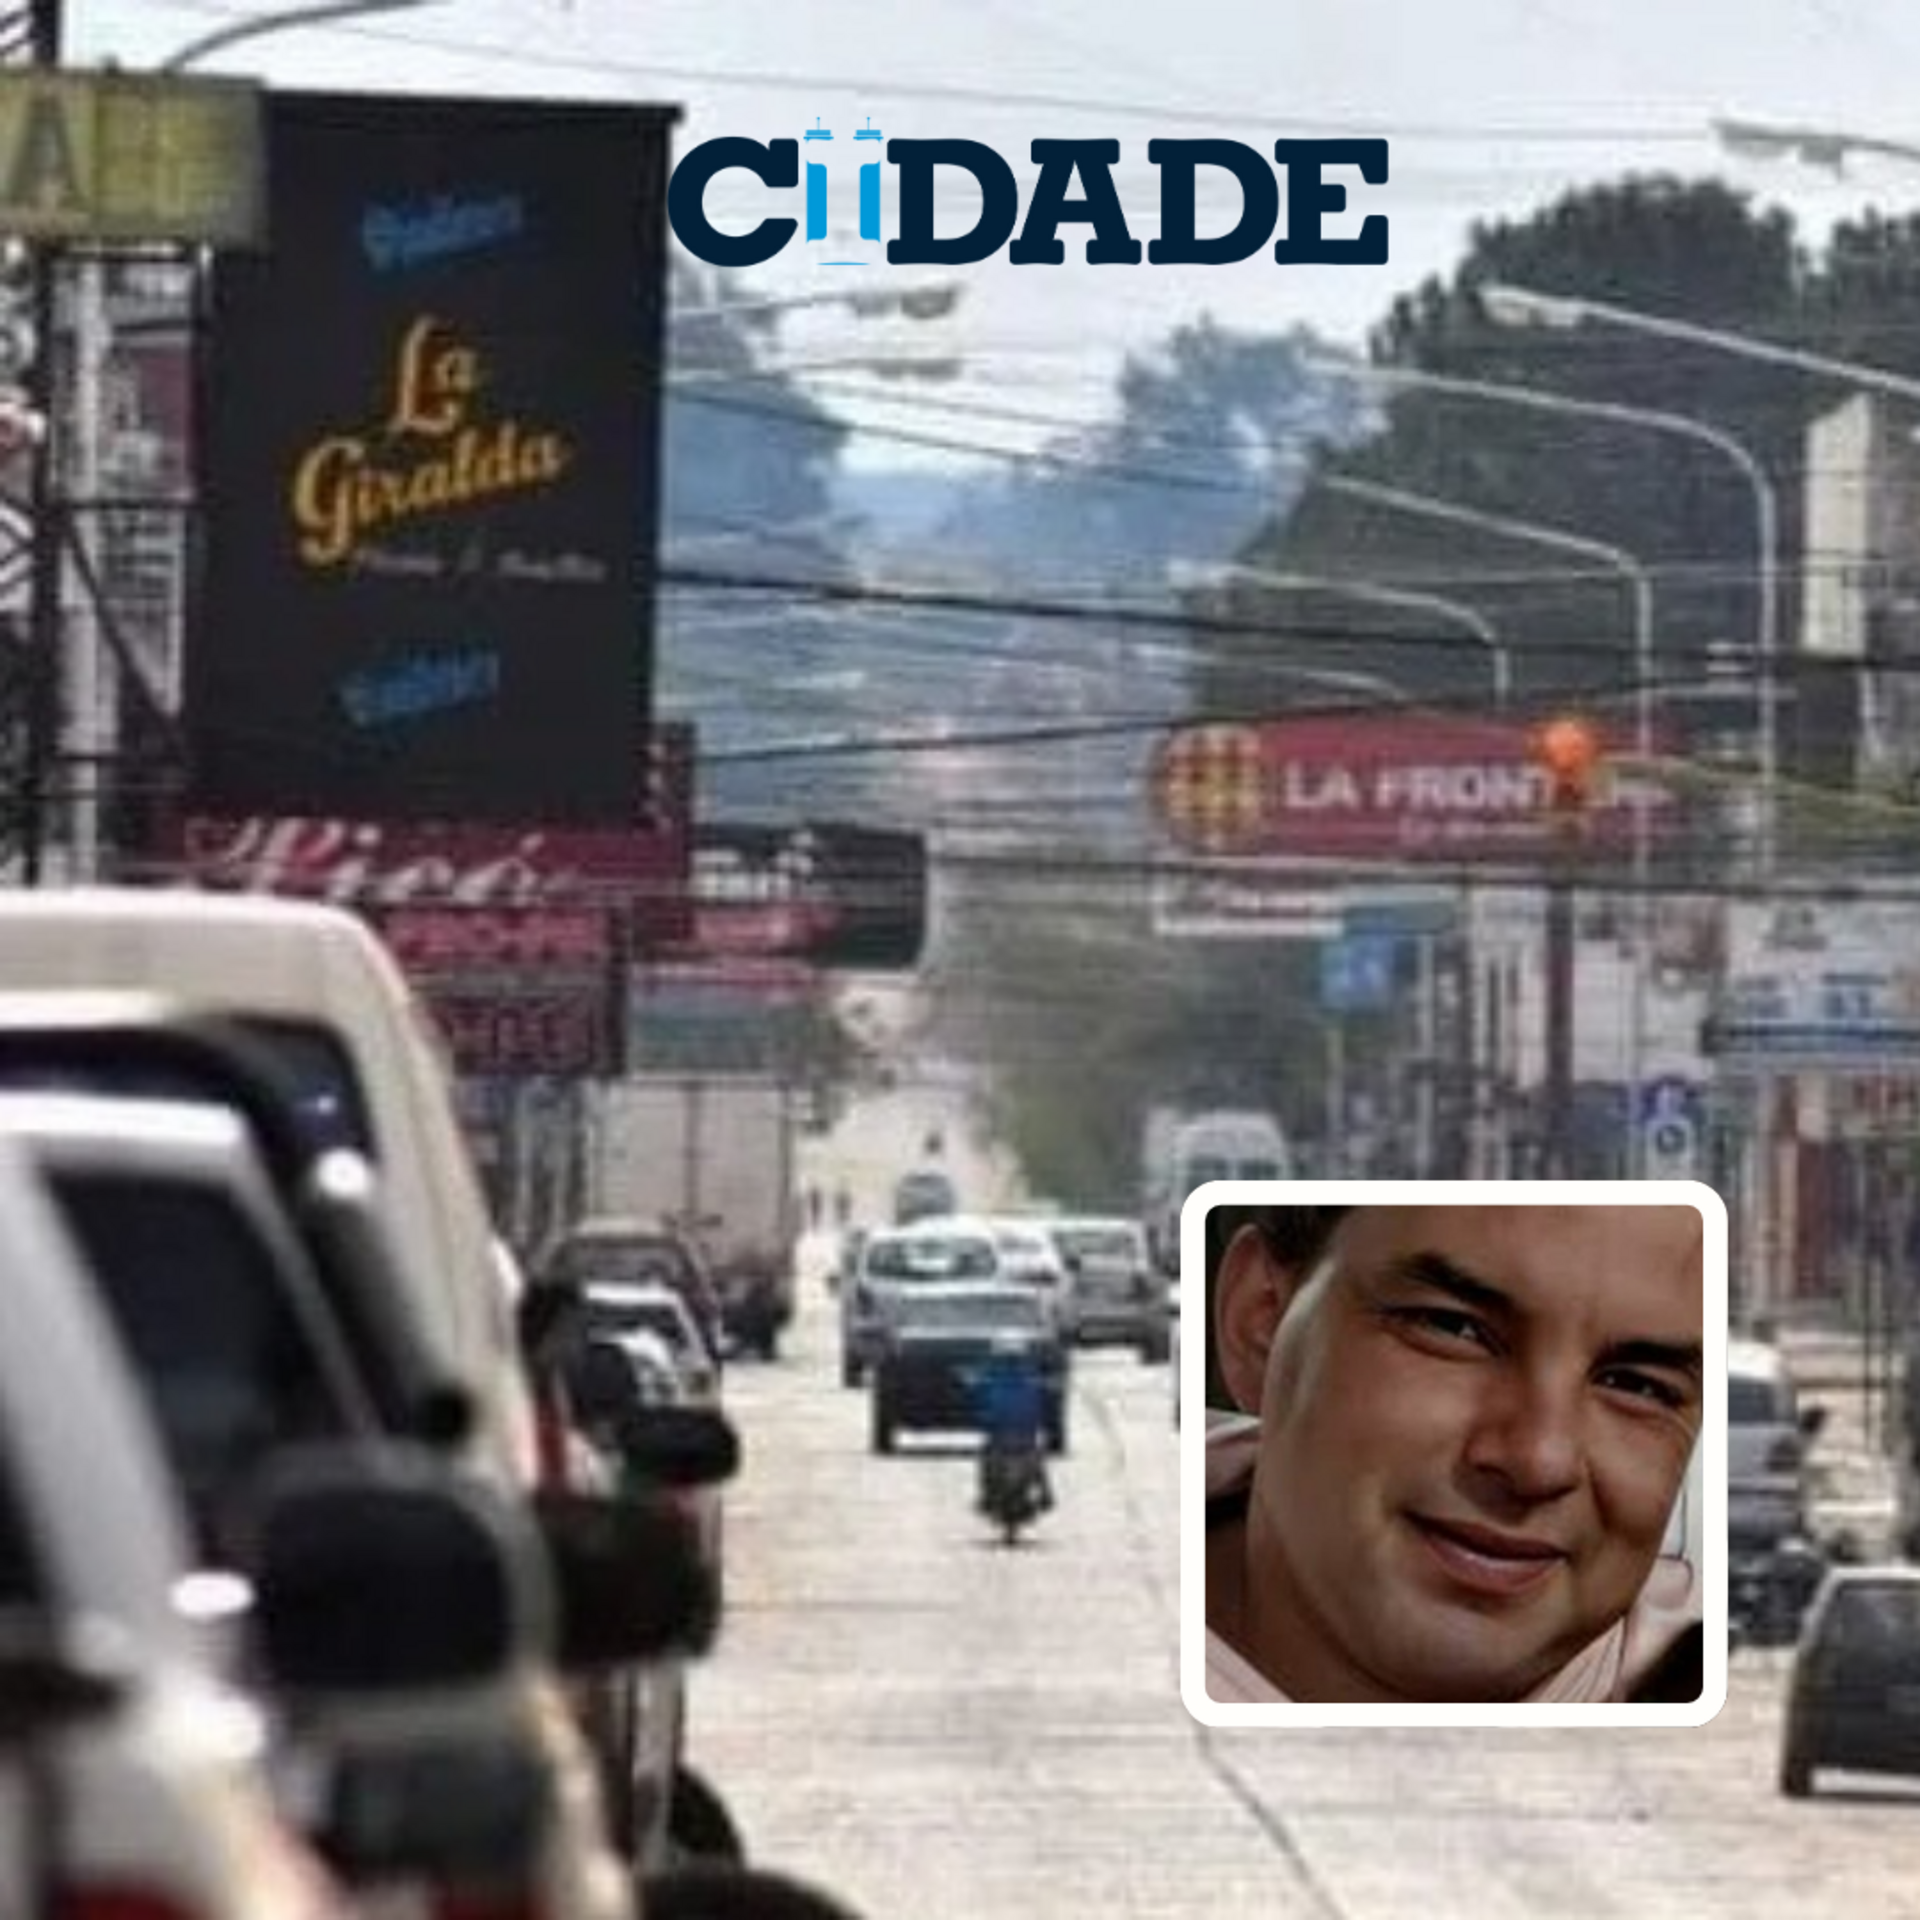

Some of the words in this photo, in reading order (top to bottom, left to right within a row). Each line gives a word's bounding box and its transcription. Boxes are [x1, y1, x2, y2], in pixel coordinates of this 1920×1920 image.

[392, 315, 479, 433] La
[293, 420, 572, 565] Giralda
[1285, 760, 1360, 808] LA
